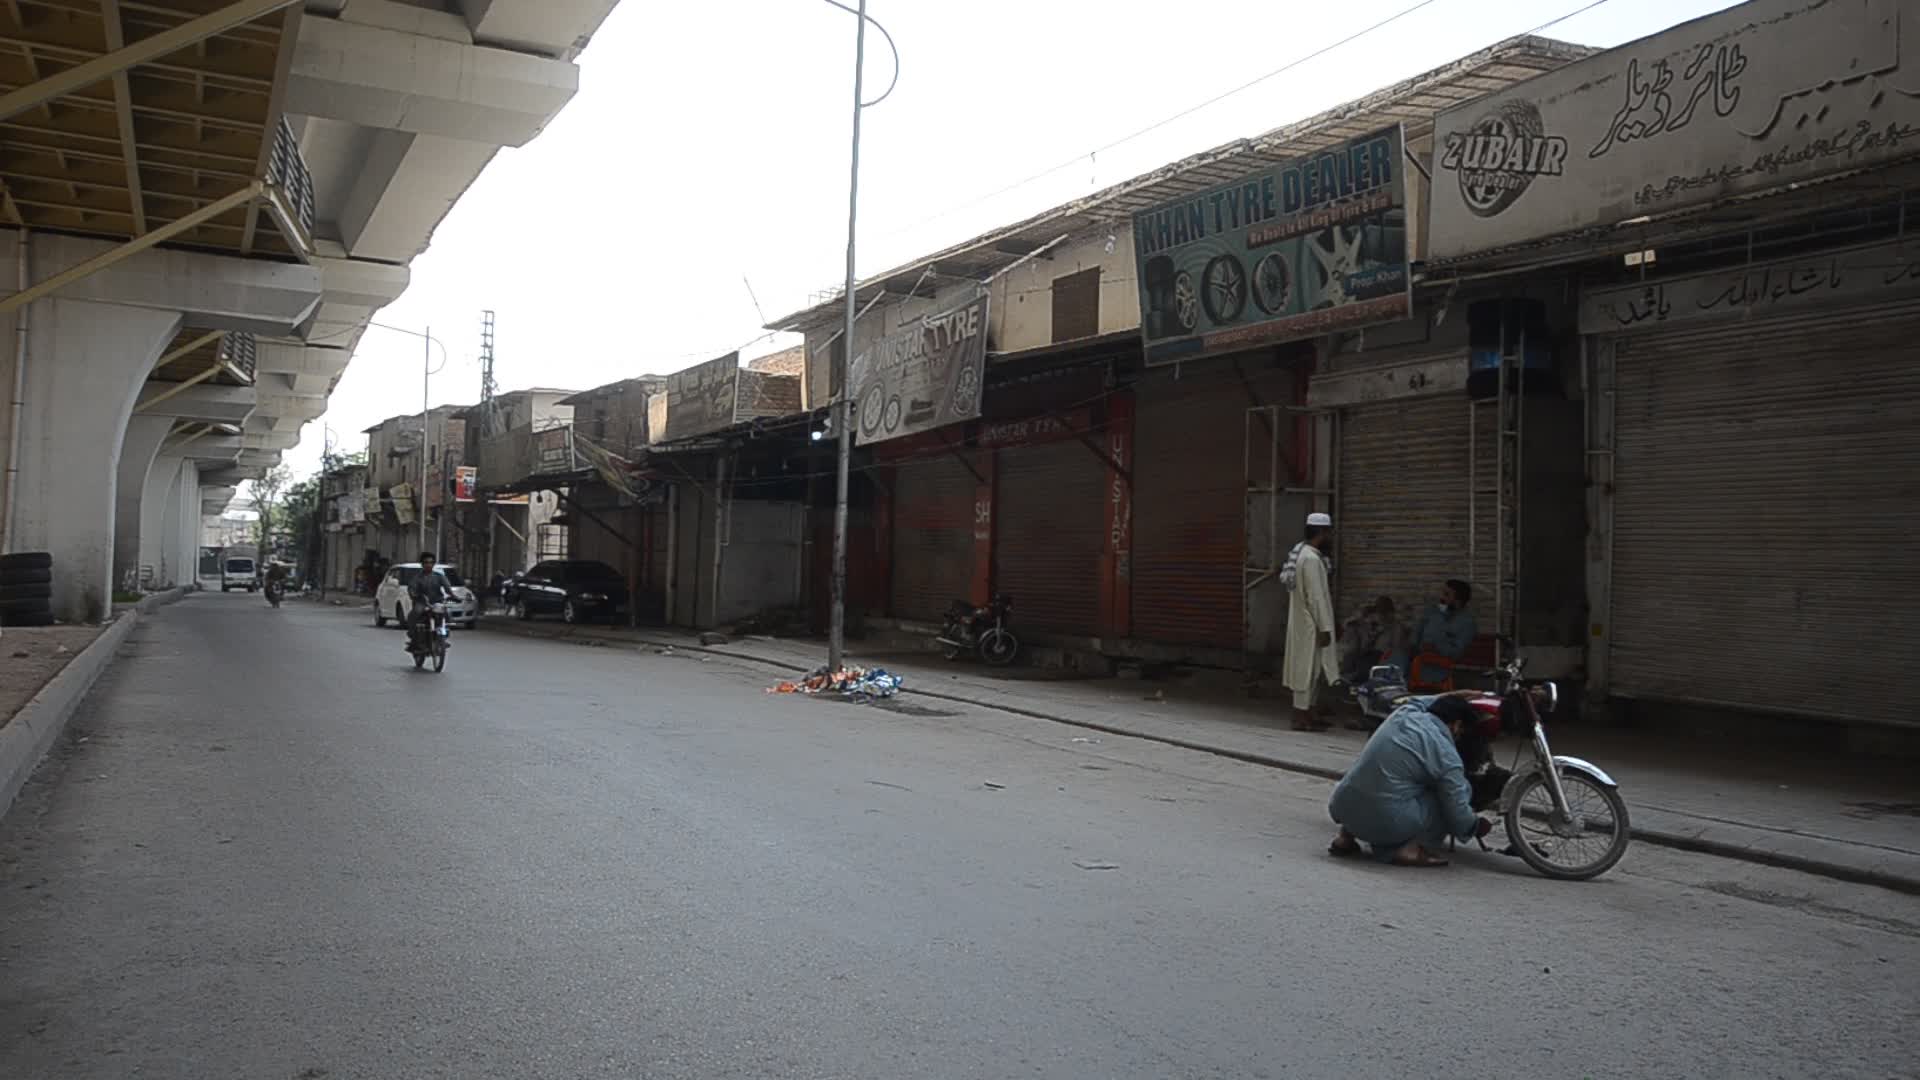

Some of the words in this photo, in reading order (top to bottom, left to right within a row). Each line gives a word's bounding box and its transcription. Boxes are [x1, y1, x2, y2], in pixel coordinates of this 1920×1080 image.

[1589, 57, 1674, 159] ڈیلر
[1667, 42, 1748, 132] ٹائر
[1441, 131, 1568, 176] ZUBAIR
[1139, 198, 1206, 256] KHAN
[1208, 173, 1276, 234] TYRE
[1282, 136, 1392, 213] DEALER
[1377, 269, 1402, 284] Khan
[928, 304, 979, 350] TYRE
